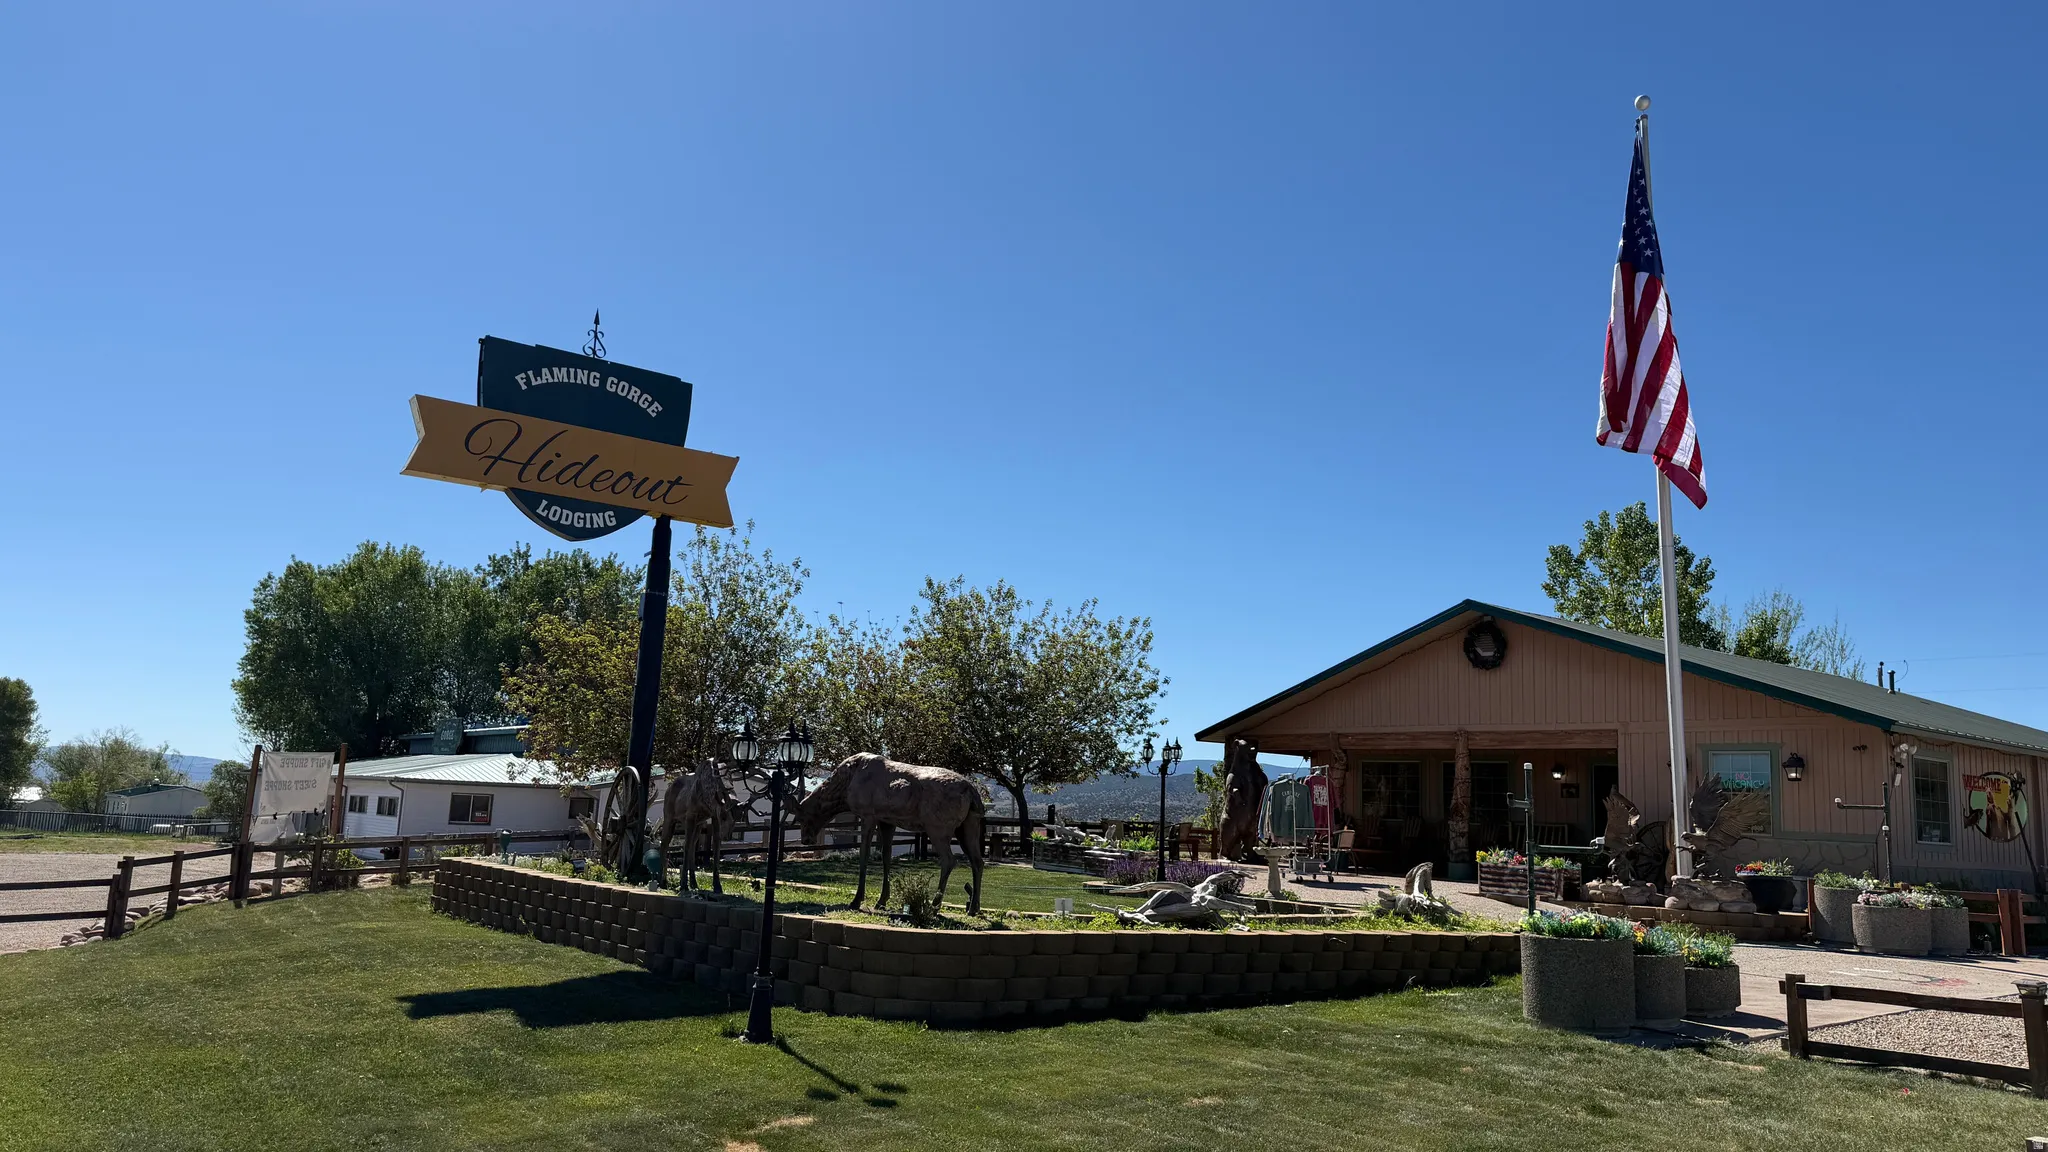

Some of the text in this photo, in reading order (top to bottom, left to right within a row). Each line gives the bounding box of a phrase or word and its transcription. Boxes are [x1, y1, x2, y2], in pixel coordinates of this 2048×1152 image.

[515, 366, 664, 418] FLAMING GORGE
[464, 418, 695, 505] Hideout
[536, 498, 617, 529] LODGING
[1722, 780, 1765, 789] VACANCY
[1962, 774, 2002, 792] WELCOME
